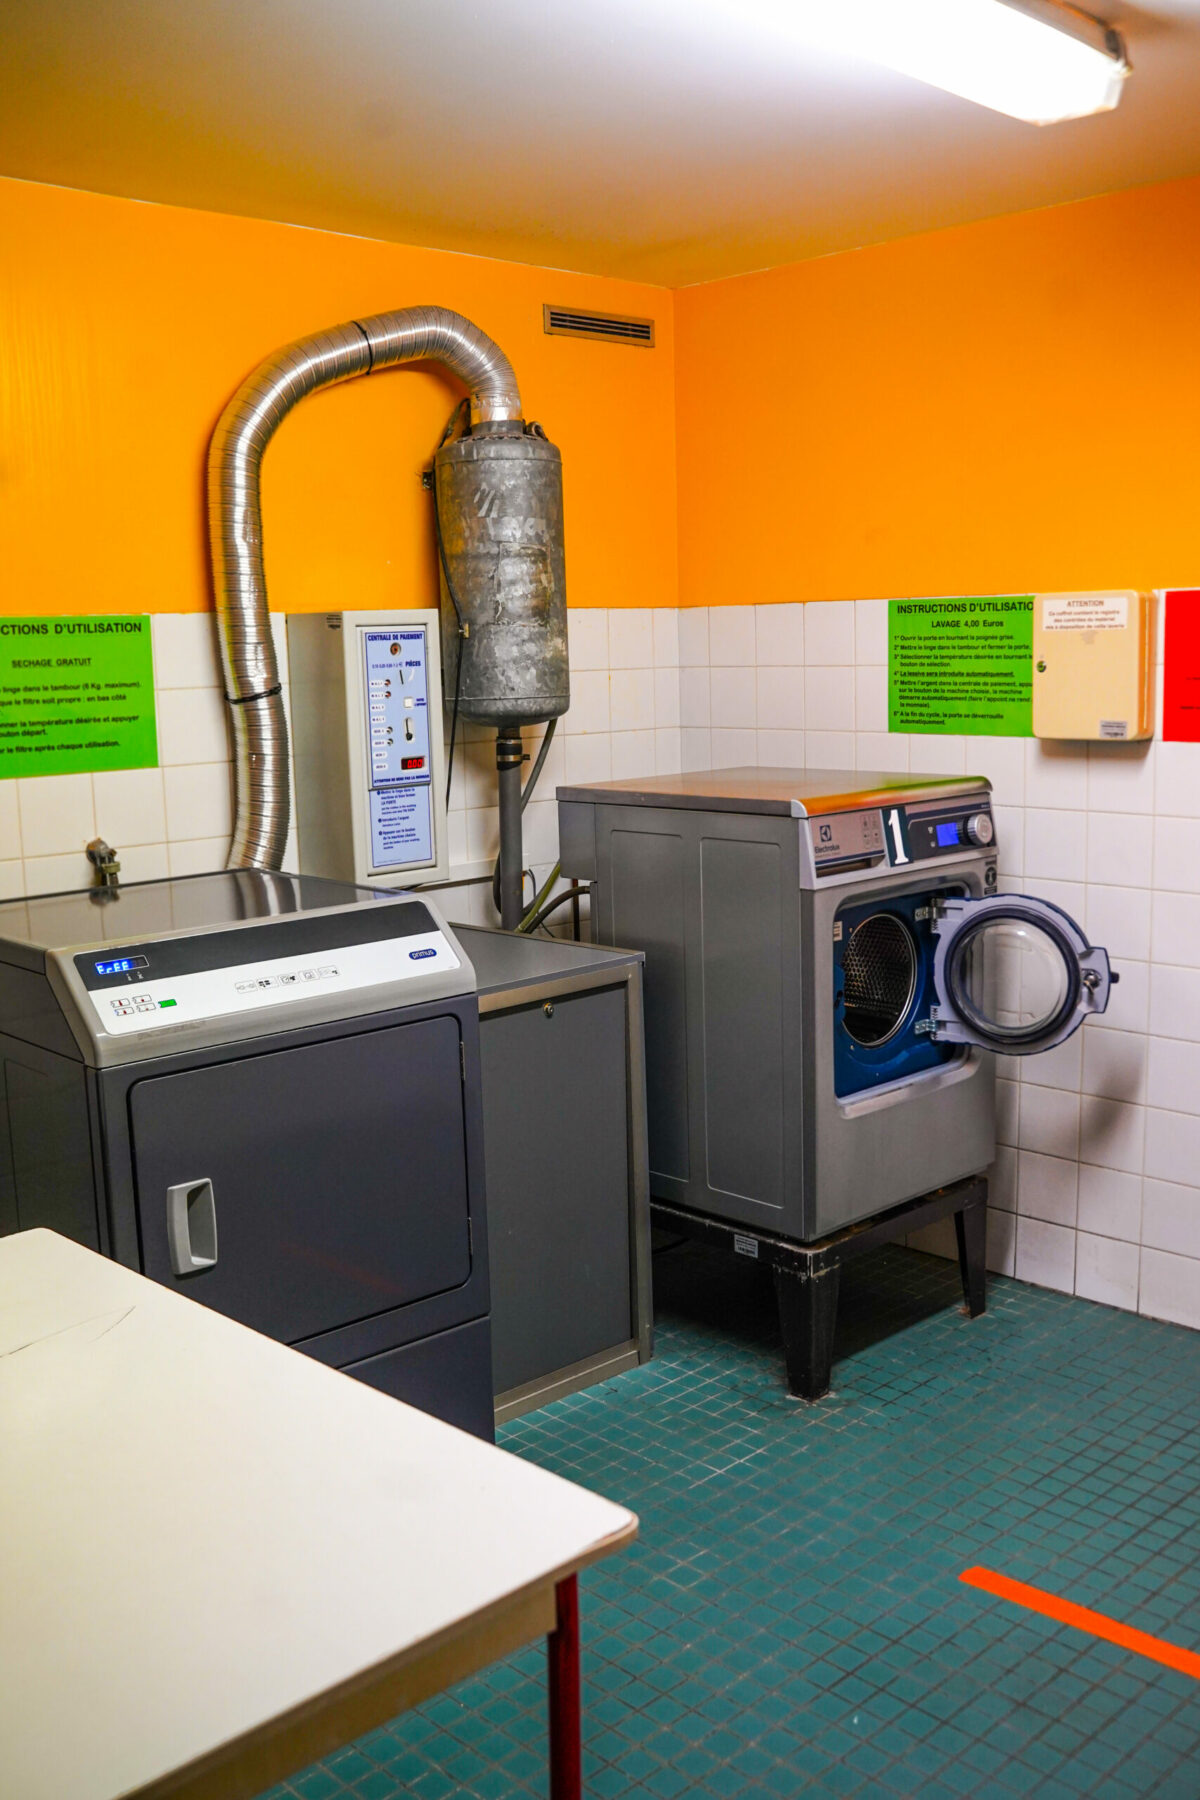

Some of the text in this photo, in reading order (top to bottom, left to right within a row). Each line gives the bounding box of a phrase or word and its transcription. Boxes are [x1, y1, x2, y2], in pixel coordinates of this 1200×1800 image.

[897, 604, 967, 614] INSTRUCTIONS
[54, 622, 142, 634] D'UTILISATION
[931, 620, 961, 628] LAVAGE
[964, 620, 980, 628] 4,00
[12, 658, 92, 668] SECHAGE GRATUIT
[888, 809, 909, 865] 1
[814, 844, 840, 854] Electrolux
[411, 950, 434, 960] primus
